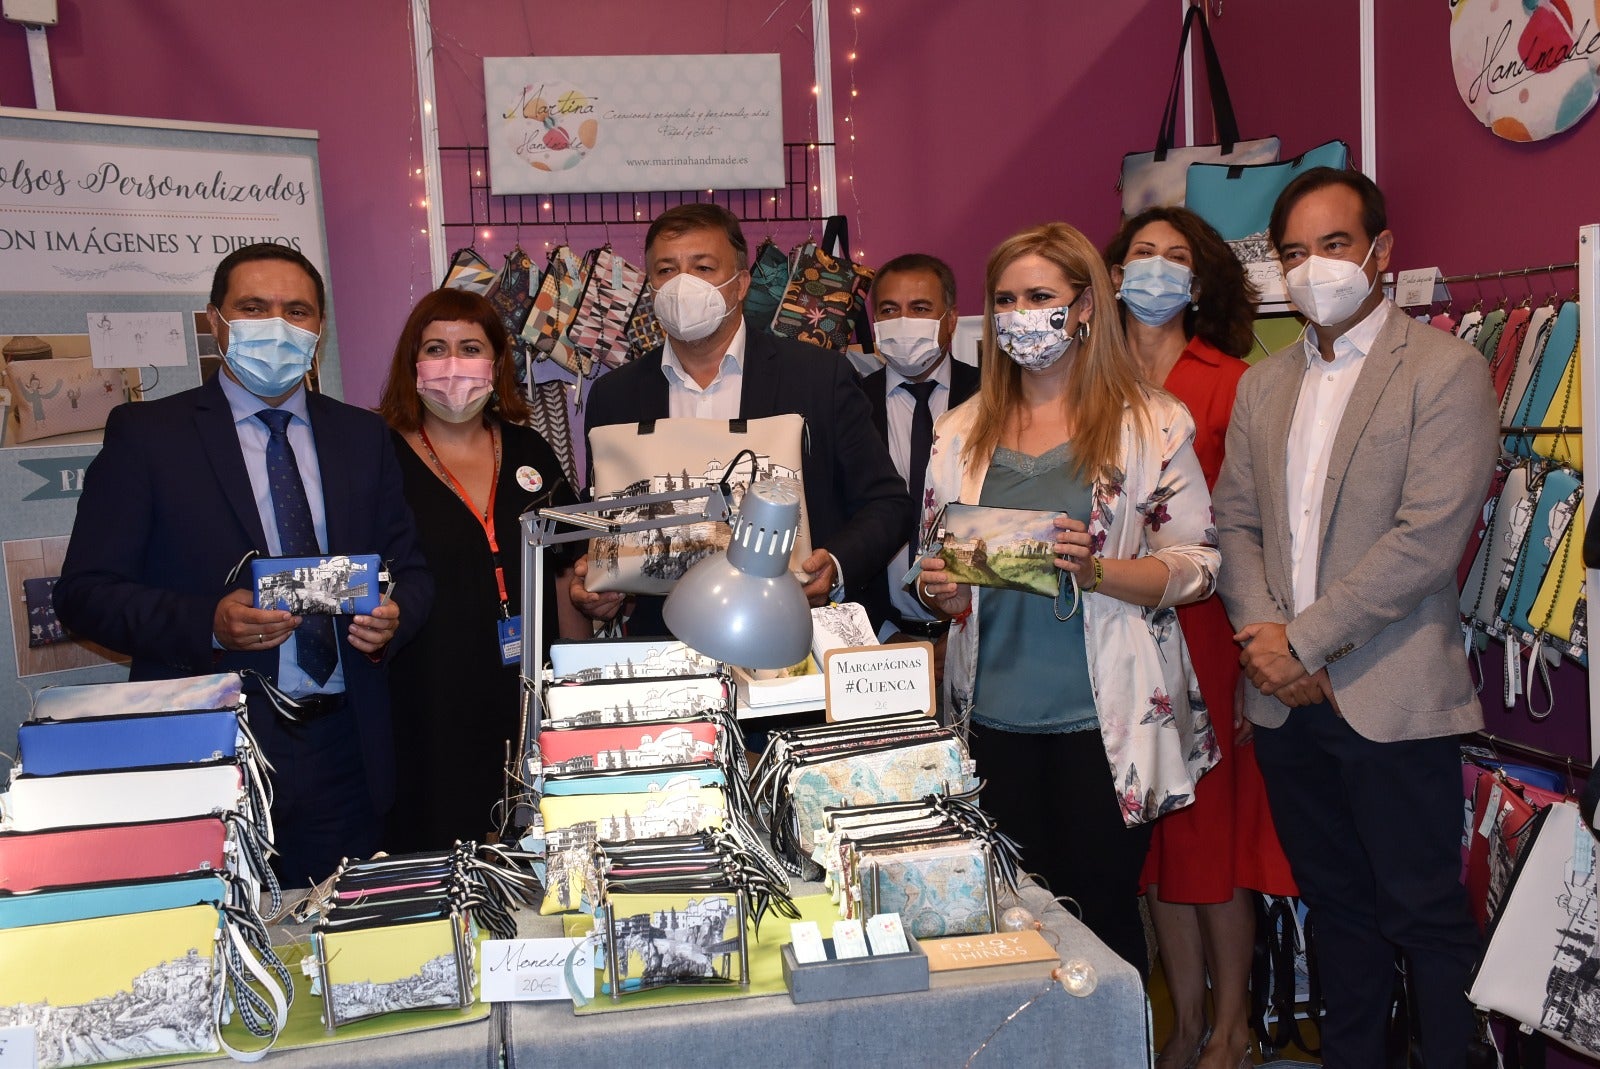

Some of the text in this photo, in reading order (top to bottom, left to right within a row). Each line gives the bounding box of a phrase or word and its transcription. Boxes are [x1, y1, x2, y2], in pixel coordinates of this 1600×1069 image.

[1469, 19, 1600, 104] Handmade
[503, 84, 598, 119] Martina
[516, 129, 583, 155] Handmade
[626, 155, 748, 167] www.martinahandmade.es
[77, 162, 310, 205] Personalizados
[45, 227, 179, 254] IMÁGENES
[186, 234, 203, 254] Y
[837, 658, 921, 674] MARCAPÁGINAS
[845, 678, 916, 694] #CUENCA
[941, 937, 1018, 951] ENJOY
[950, 946, 1027, 961] THINGS
[490, 943, 586, 972] Monedeo
